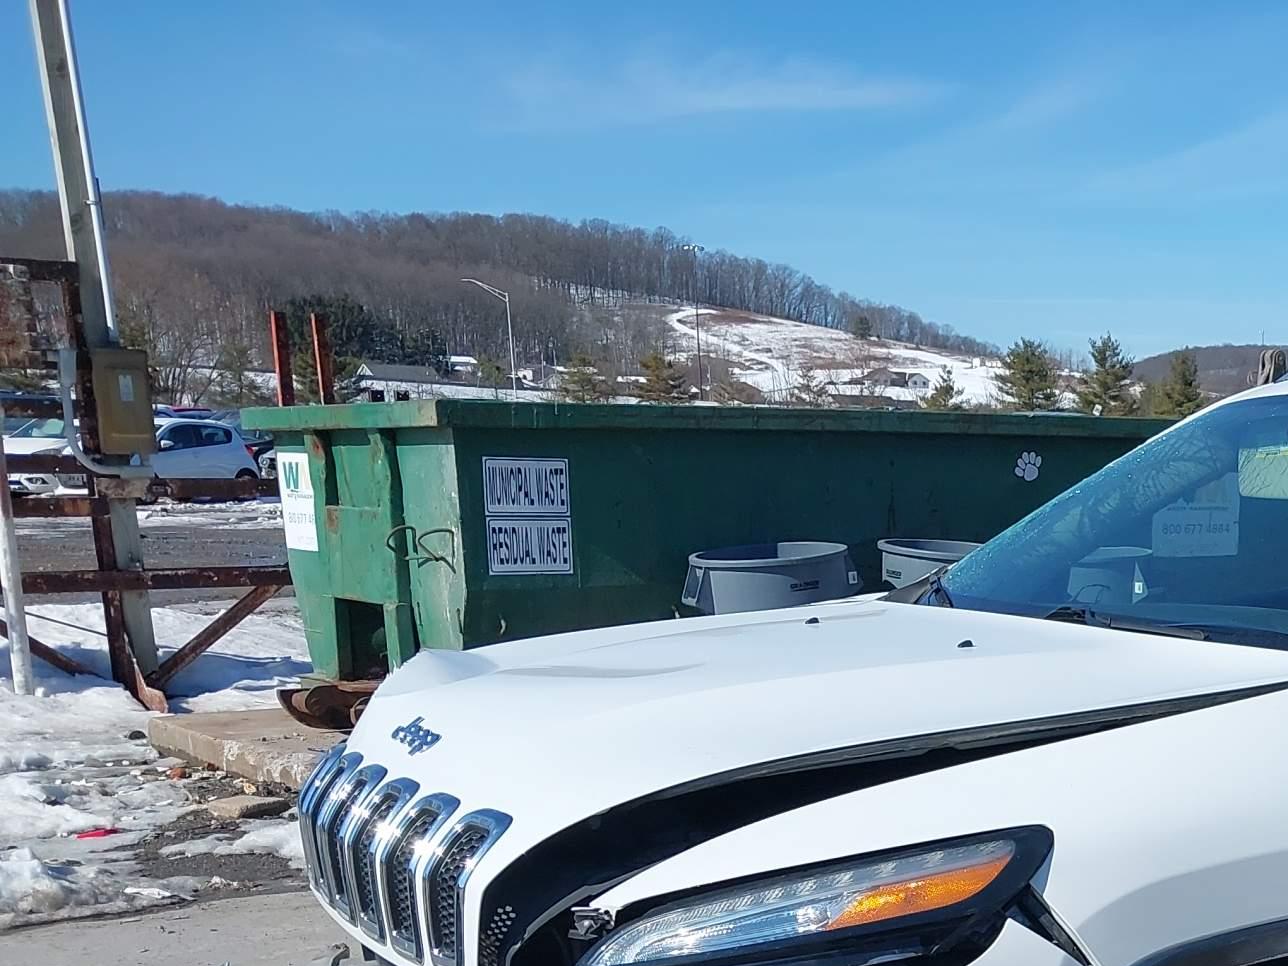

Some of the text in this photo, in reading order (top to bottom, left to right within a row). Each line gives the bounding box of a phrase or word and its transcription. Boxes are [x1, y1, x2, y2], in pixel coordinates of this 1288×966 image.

[488, 466, 565, 507] MUNICIPAL WASTE
[491, 526, 568, 566] RESIDUAL WASTE
[1161, 523, 1181, 535] 800
[1184, 523, 1203, 535] 677
